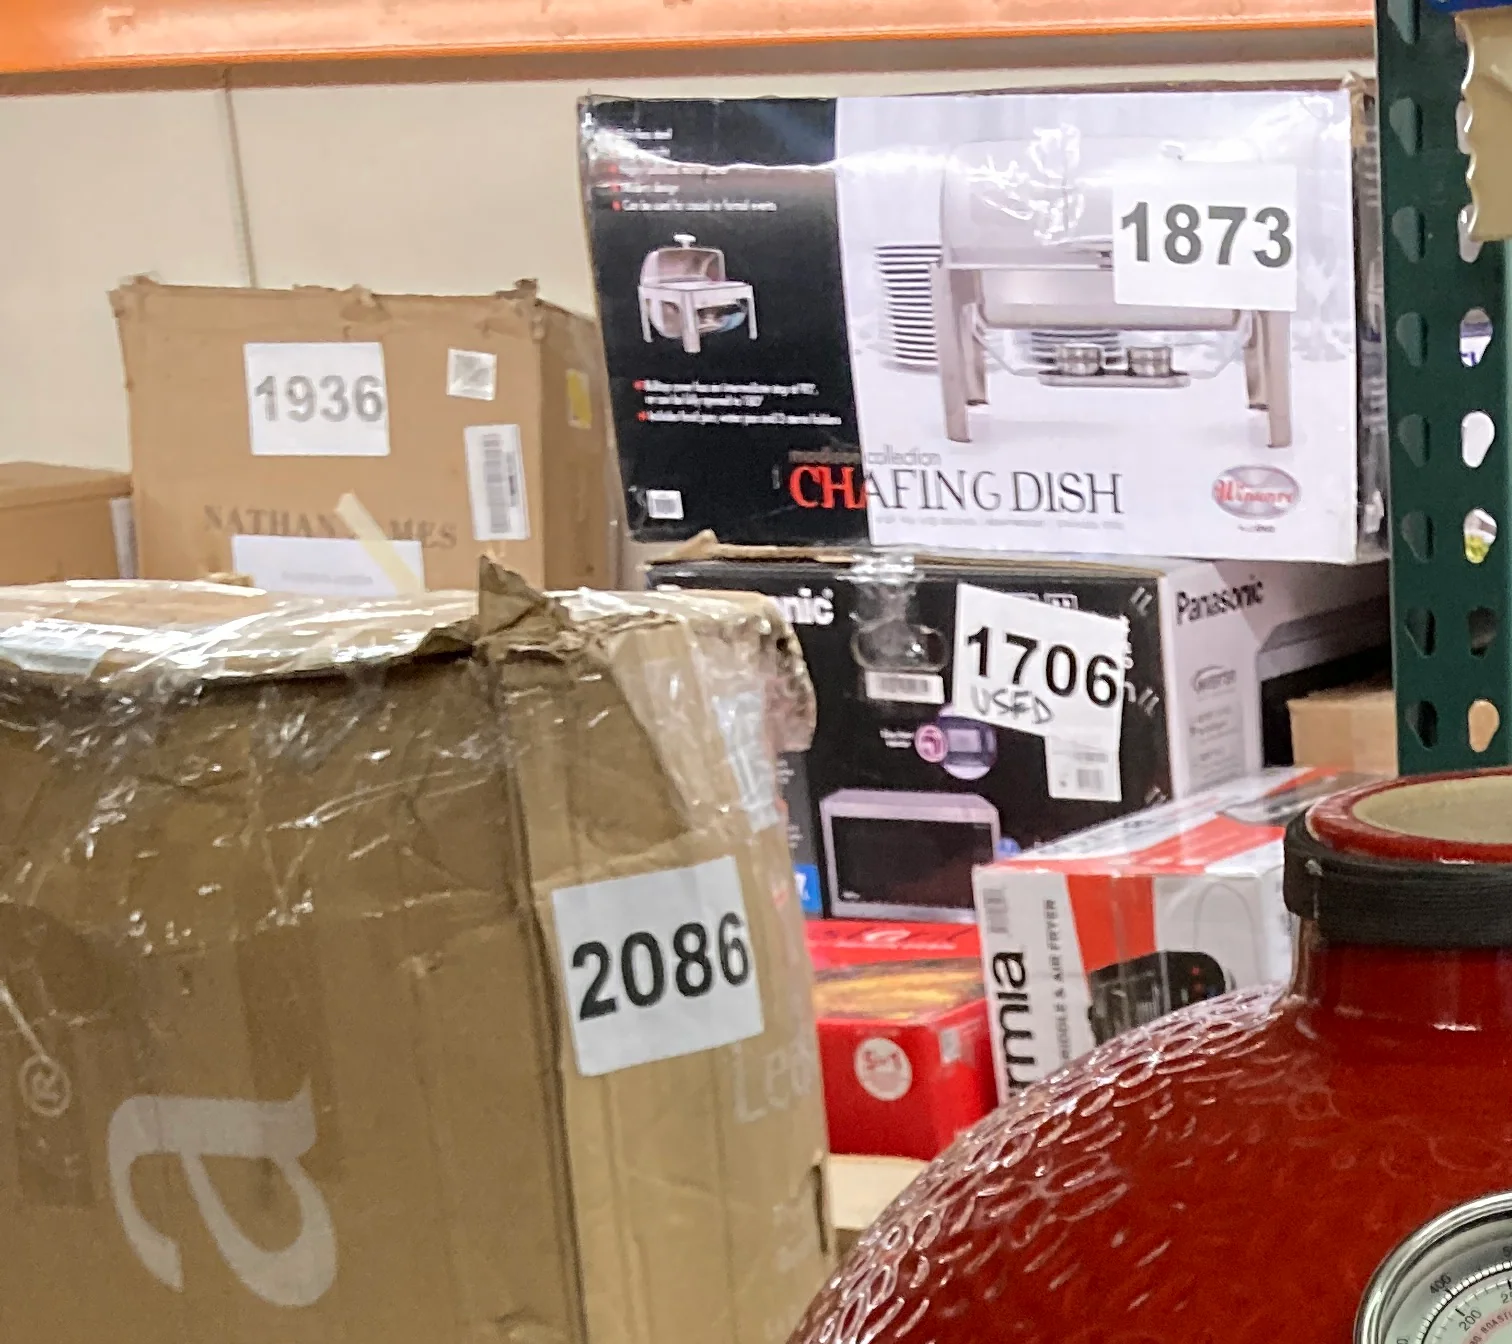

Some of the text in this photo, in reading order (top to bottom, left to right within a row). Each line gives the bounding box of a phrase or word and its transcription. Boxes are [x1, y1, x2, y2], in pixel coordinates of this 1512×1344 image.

[1120, 201, 1293, 268] 1873
[254, 374, 385, 423] 1936
[789, 464, 1126, 514] CHAFING DISH
[1176, 574, 1265, 626] Panasonic
[967, 626, 1119, 708] 1706
[970, 685, 1055, 725] USED
[1042, 898, 1062, 951] FRYER
[571, 912, 753, 1021] 2086
[1429, 1274, 1452, 1294] 400
[1459, 1309, 1483, 1332] 200
